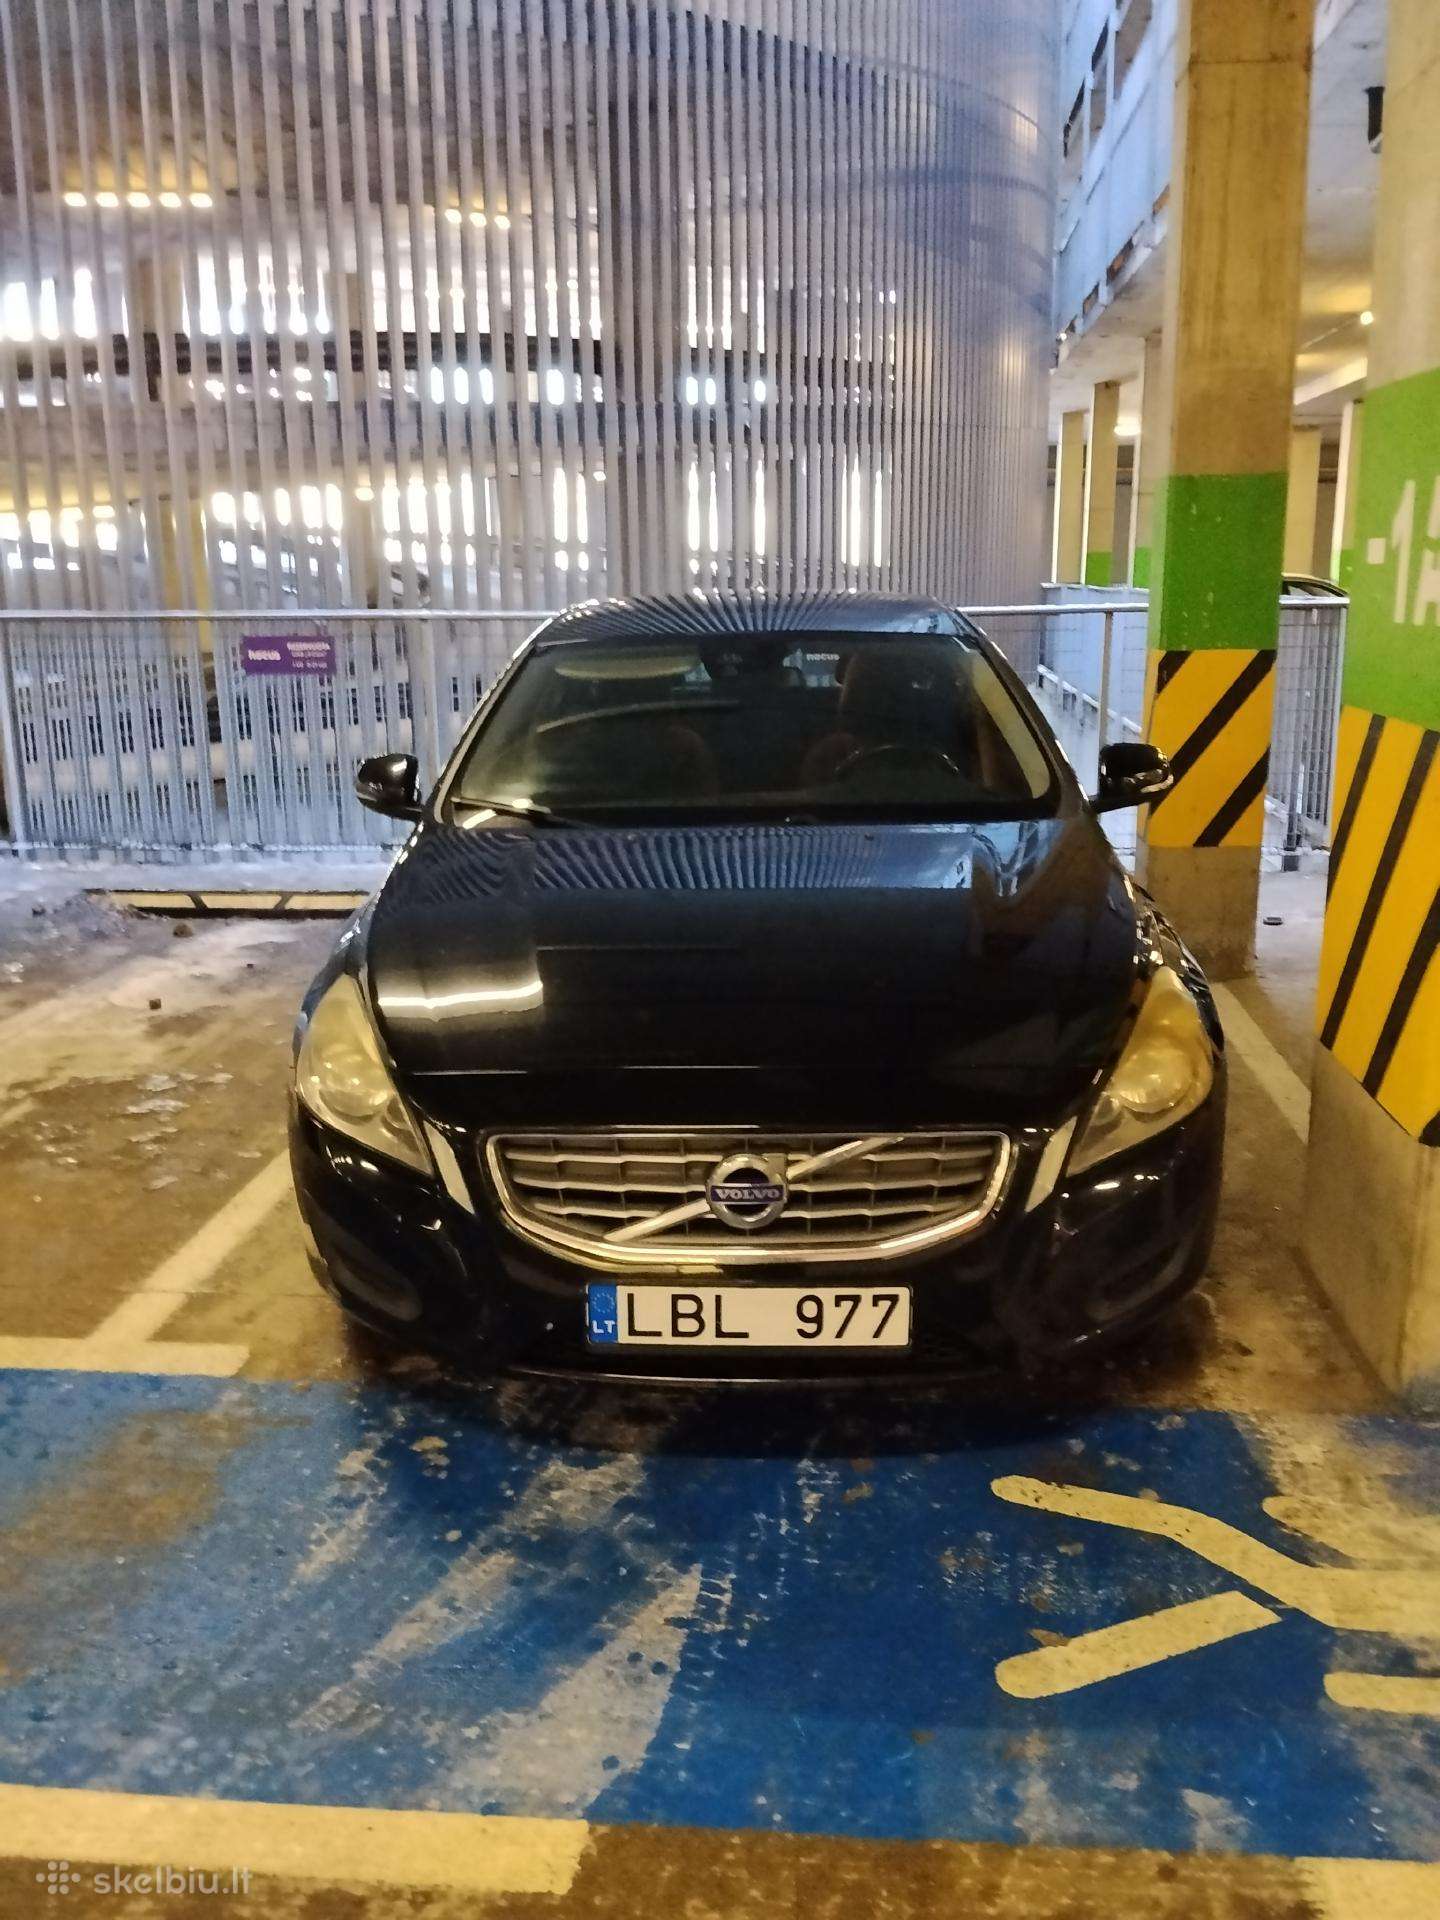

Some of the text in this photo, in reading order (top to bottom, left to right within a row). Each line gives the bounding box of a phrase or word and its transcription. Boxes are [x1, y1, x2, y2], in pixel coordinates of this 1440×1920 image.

[716, 1187, 780, 1200] VOLVO
[627, 1293, 900, 1339] LBL 977
[592, 1319, 616, 1335] LT
